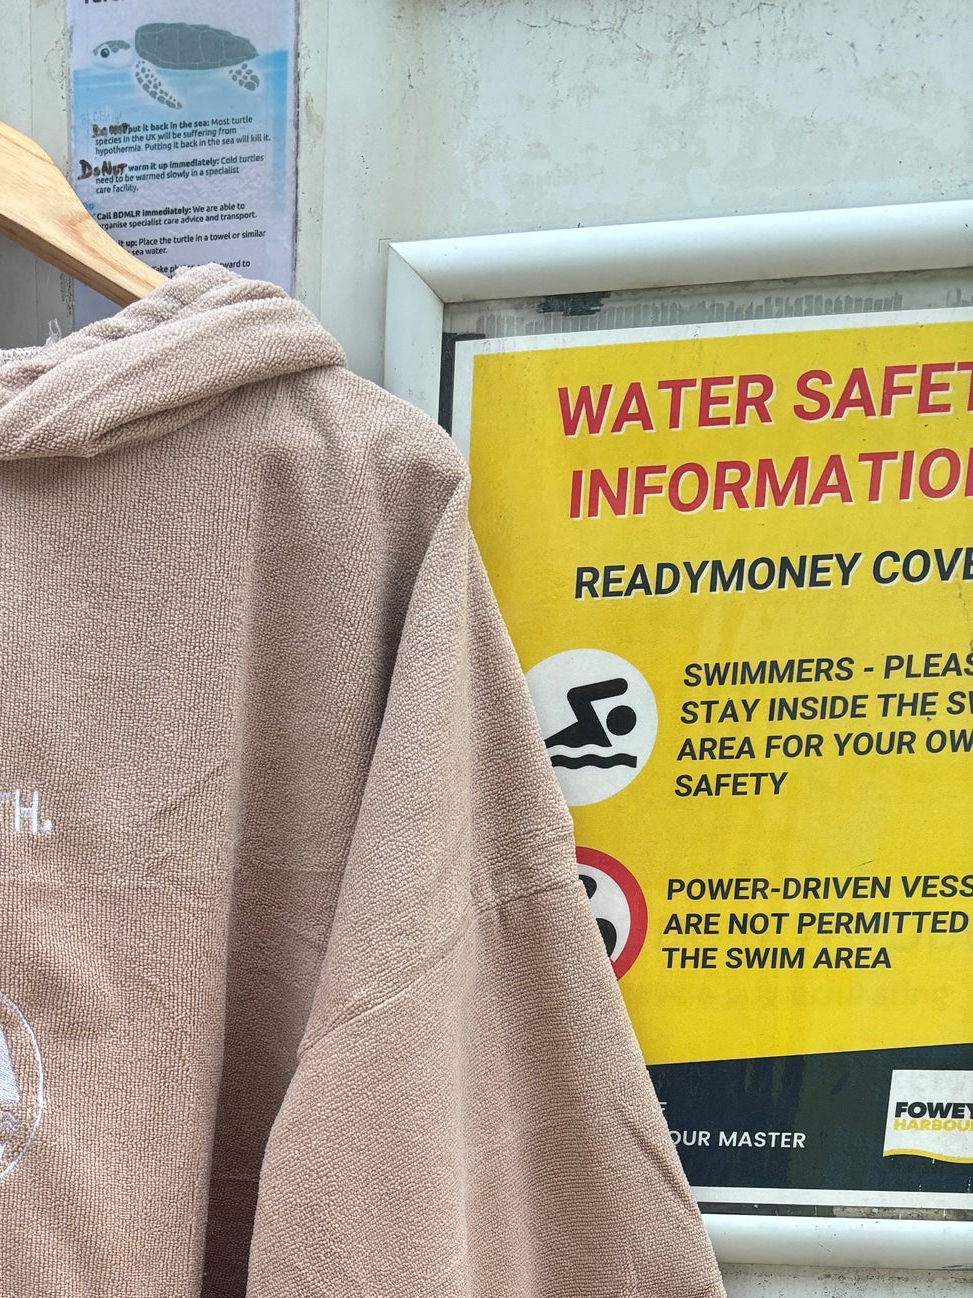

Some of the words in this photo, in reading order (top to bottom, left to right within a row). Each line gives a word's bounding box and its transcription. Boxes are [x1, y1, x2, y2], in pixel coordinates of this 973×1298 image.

[128, 126, 141, 134] put
[143, 123, 148, 131] it
[151, 122, 168, 131] back
[170, 121, 177, 129] in
[179, 120, 192, 129] the
[211, 118, 230, 126] Most
[232, 115, 253, 124] turtle
[95, 137, 122, 146] species
[132, 134, 144, 142] the
[146, 133, 156, 141] UK
[158, 131, 171, 140] will
[172, 131, 182, 139] be
[183, 129, 217, 138] suffering
[218, 127, 237, 135] from
[95, 145, 143, 156] hypothermia.
[145, 141, 172, 151] Putting
[180, 139, 198, 148] back
[207, 138, 220, 146] the
[222, 137, 235, 145] sea
[236, 135, 249, 143] will
[250, 134, 262, 142] kill
[263, 133, 271, 141] it.
[128, 163, 149, 172] warm
[158, 162, 168, 171] up
[170, 157, 220, 169] immediately:
[221, 155, 238, 165] Cold
[239, 154, 265, 163] turtles
[95, 176, 114, 185] need
[115, 175, 123, 183] to
[125, 173, 134, 182] be
[135, 171, 165, 181] warmed
[166, 170, 190, 179] slowly
[205, 166, 240, 177] specialist
[95, 186, 111, 194] care
[112, 183, 139, 193] facility.
[96, 211, 112, 220] Call
[113, 210, 141, 219] BDMLR
[142, 205, 191, 217] immediately:
[192, 205, 205, 213] We
[219, 203, 235, 211] able
[237, 202, 245, 210] to
[129, 217, 162, 228] specialist
[163, 217, 179, 225] care
[180, 215, 204, 224] advice
[205, 213, 219, 221] and
[220, 211, 257, 221] transport.
[126, 239, 137, 248] up:
[138, 238, 158, 246] Place
[159, 236, 172, 245] the
[173, 234, 194, 244] turtle
[210, 232, 231, 241] towel
[241, 230, 266, 239] similar
[131, 248, 144, 256] sea
[145, 247, 168, 255] water.
[557, 373, 775, 438] WATER
[569, 447, 973, 519] INFORMATIO
[574, 552, 862, 599] READYMONEY
[683, 656, 855, 687] SWIMMERS
[680, 697, 760, 724] STAY
[768, 693, 870, 721] INSIDE
[877, 691, 939, 717] THE
[677, 736, 756, 761] AREA
[765, 734, 824, 758] FOR
[833, 731, 916, 756] YOUR
[674, 772, 788, 797] SAFETY
[667, 875, 892, 900] POWER-DRIVEN
[663, 912, 720, 935] ARE
[729, 912, 788, 935] NOT
[797, 911, 969, 935] PERMITTED
[662, 946, 717, 969] THE
[725, 946, 806, 969] SWIM
[813, 946, 892, 969] AREA
[894, 1119, 973, 1132] HARBOU
[718, 1131, 806, 1149] MASTER
